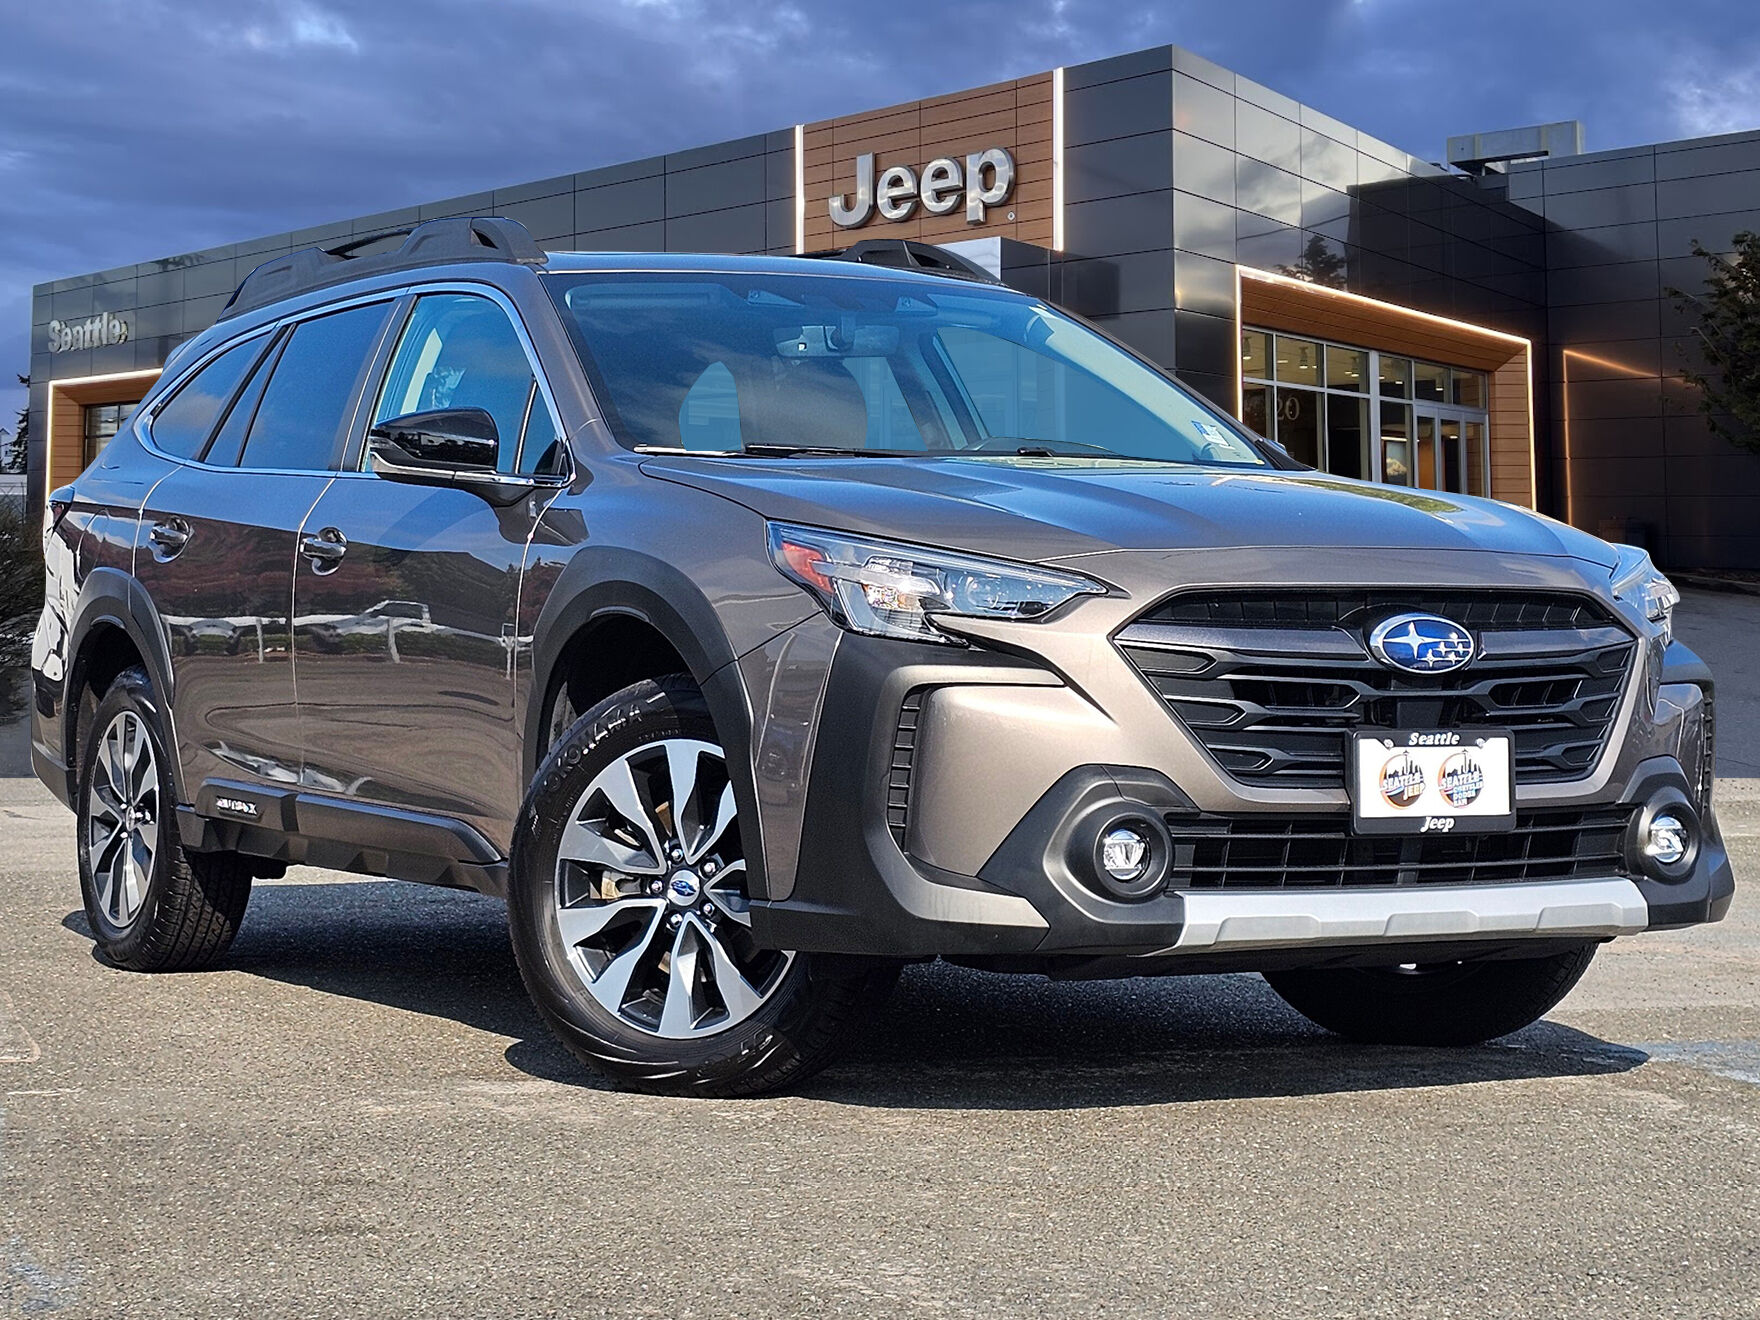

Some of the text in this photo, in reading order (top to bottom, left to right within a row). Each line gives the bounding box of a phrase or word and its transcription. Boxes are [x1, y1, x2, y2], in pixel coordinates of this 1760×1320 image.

[828, 148, 1016, 229] Jeep
[47, 312, 127, 353] Seattle
[1408, 731, 1460, 746] Seattle
[1381, 771, 1422, 791] SEATTLE
[1440, 770, 1481, 789] SEATTLE
[1403, 781, 1426, 801] JEEP
[1420, 816, 1455, 833] Jeep
